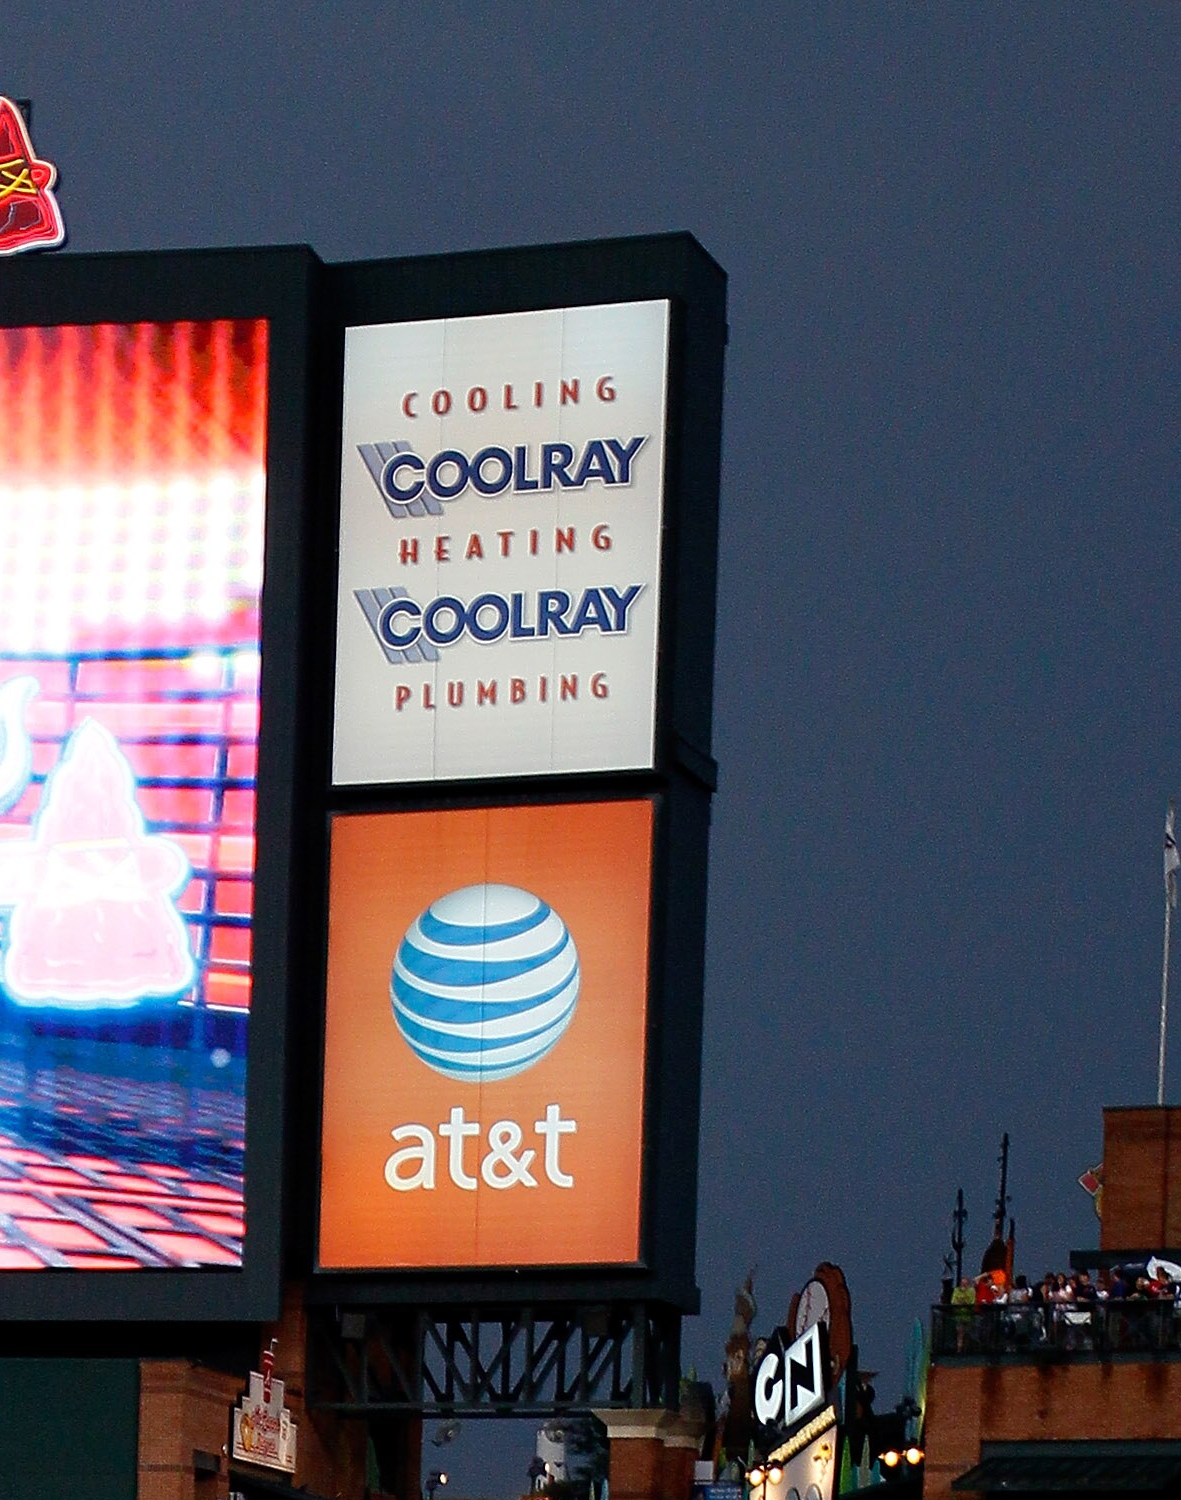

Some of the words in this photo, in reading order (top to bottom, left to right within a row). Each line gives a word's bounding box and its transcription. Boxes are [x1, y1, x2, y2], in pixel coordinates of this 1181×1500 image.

[401, 375, 618, 418] COOLING
[383, 434, 650, 504] COOLRAY
[397, 523, 612, 565] HEATING
[378, 583, 646, 651] COOLRAY
[395, 671, 609, 711] PLUMBING
[384, 1103, 577, 1191] at&t
